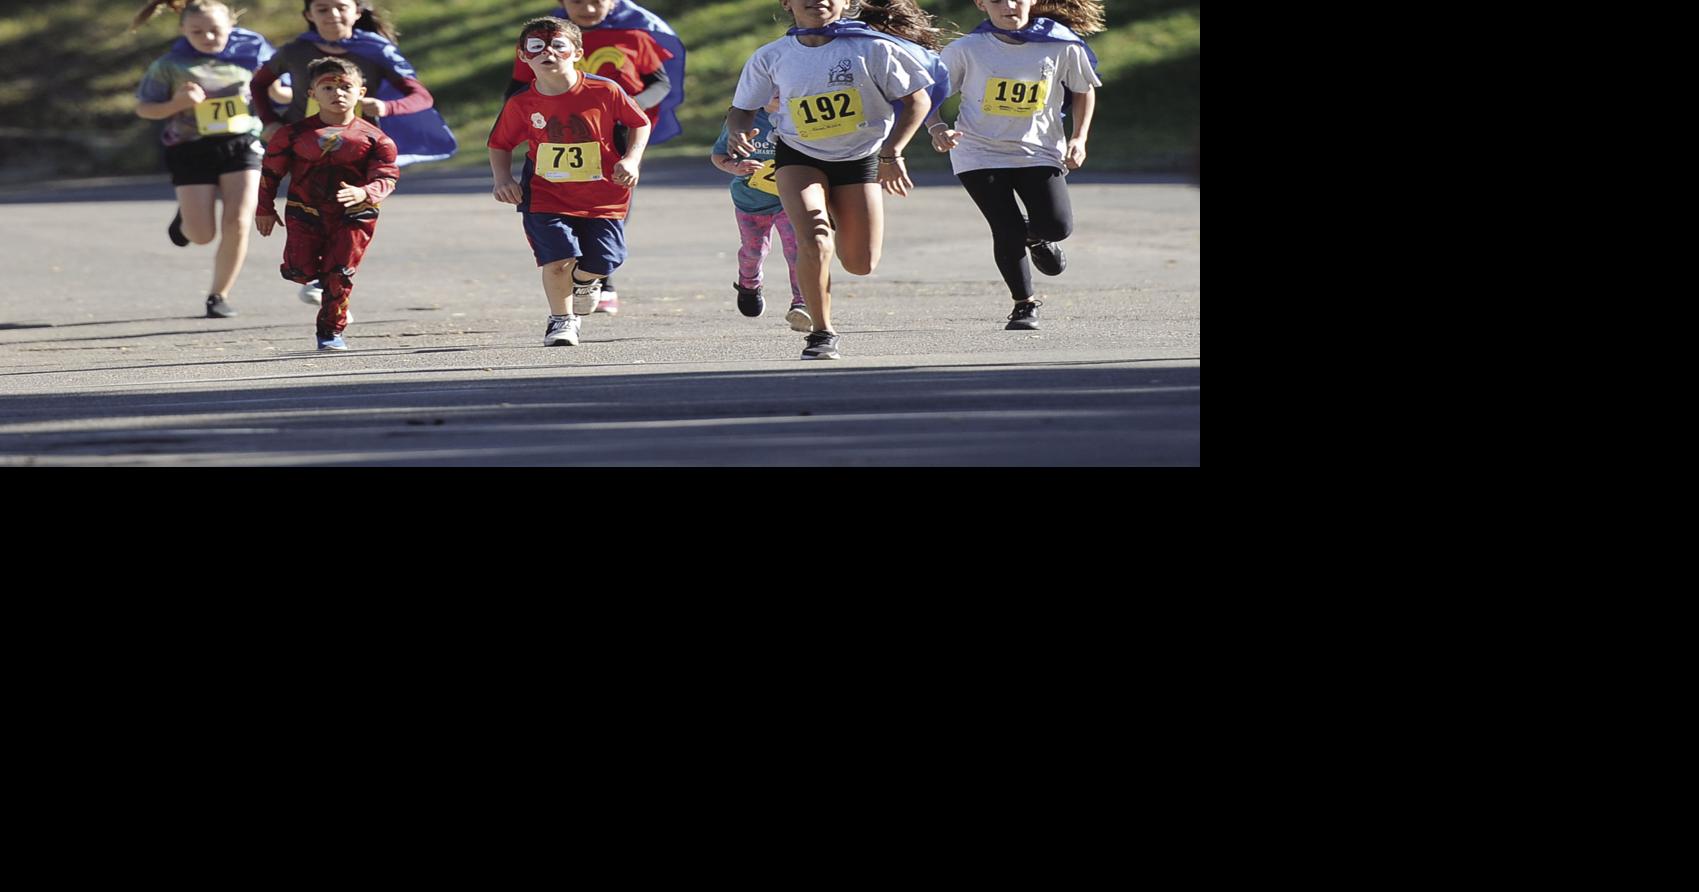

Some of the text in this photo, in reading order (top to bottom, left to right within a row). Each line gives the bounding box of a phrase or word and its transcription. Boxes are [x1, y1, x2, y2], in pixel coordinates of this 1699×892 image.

[995, 81, 1039, 104] 191
[209, 101, 236, 119] 70
[799, 93, 856, 124] 192
[552, 147, 583, 168] 73
